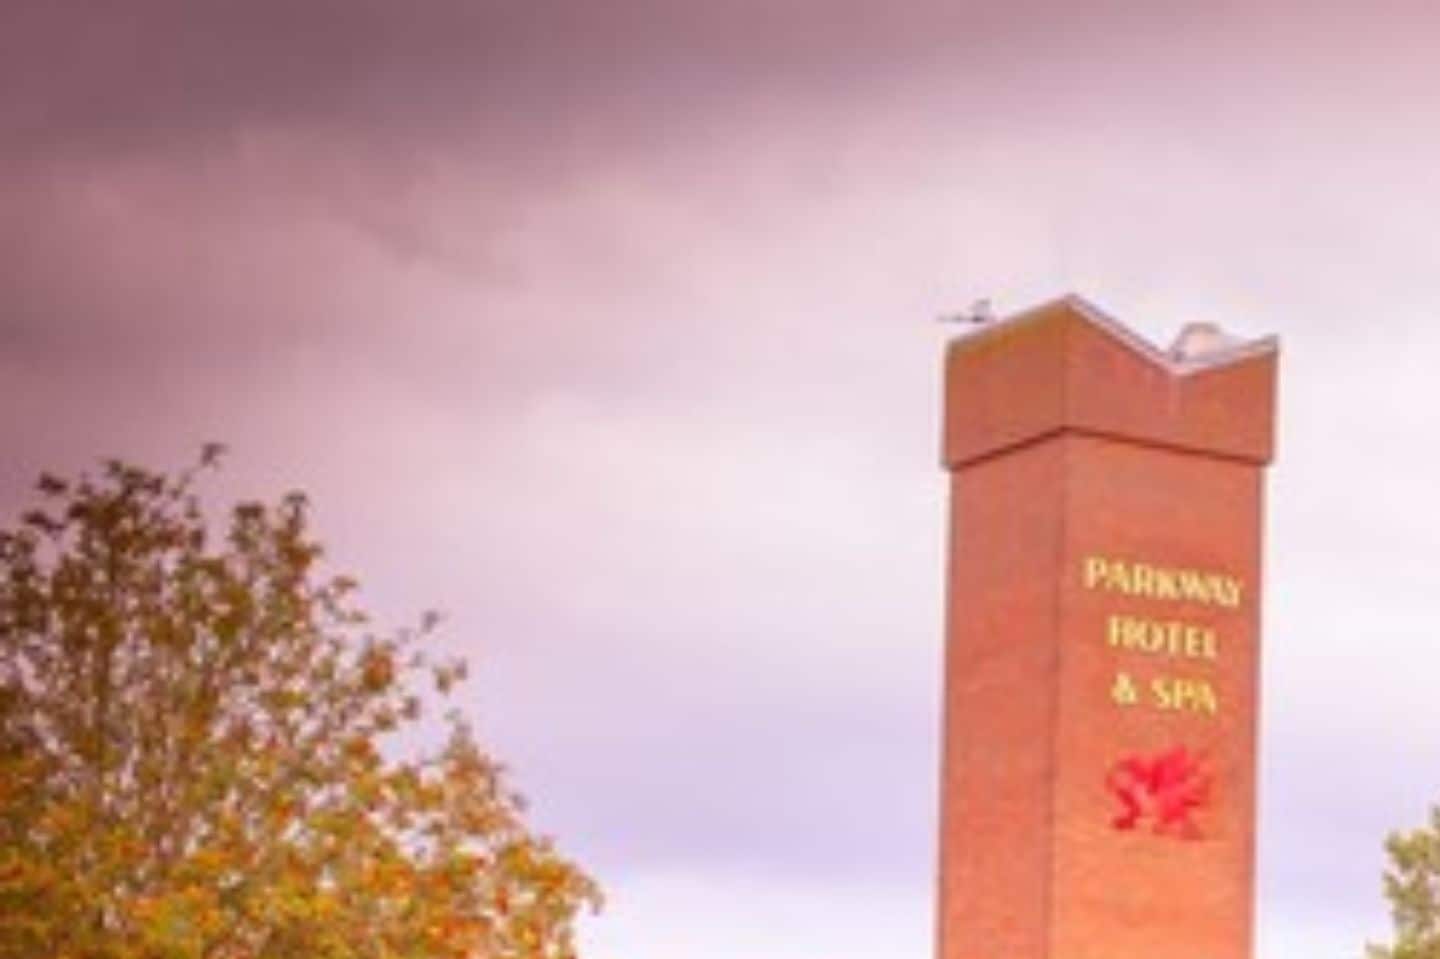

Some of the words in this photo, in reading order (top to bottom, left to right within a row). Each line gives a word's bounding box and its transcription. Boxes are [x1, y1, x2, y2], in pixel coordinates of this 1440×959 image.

[1083, 556, 1243, 608] PARKWAY
[1108, 615, 1218, 659] HOTEL
[1111, 671, 1138, 705] &
[1152, 678, 1217, 716] SPA
